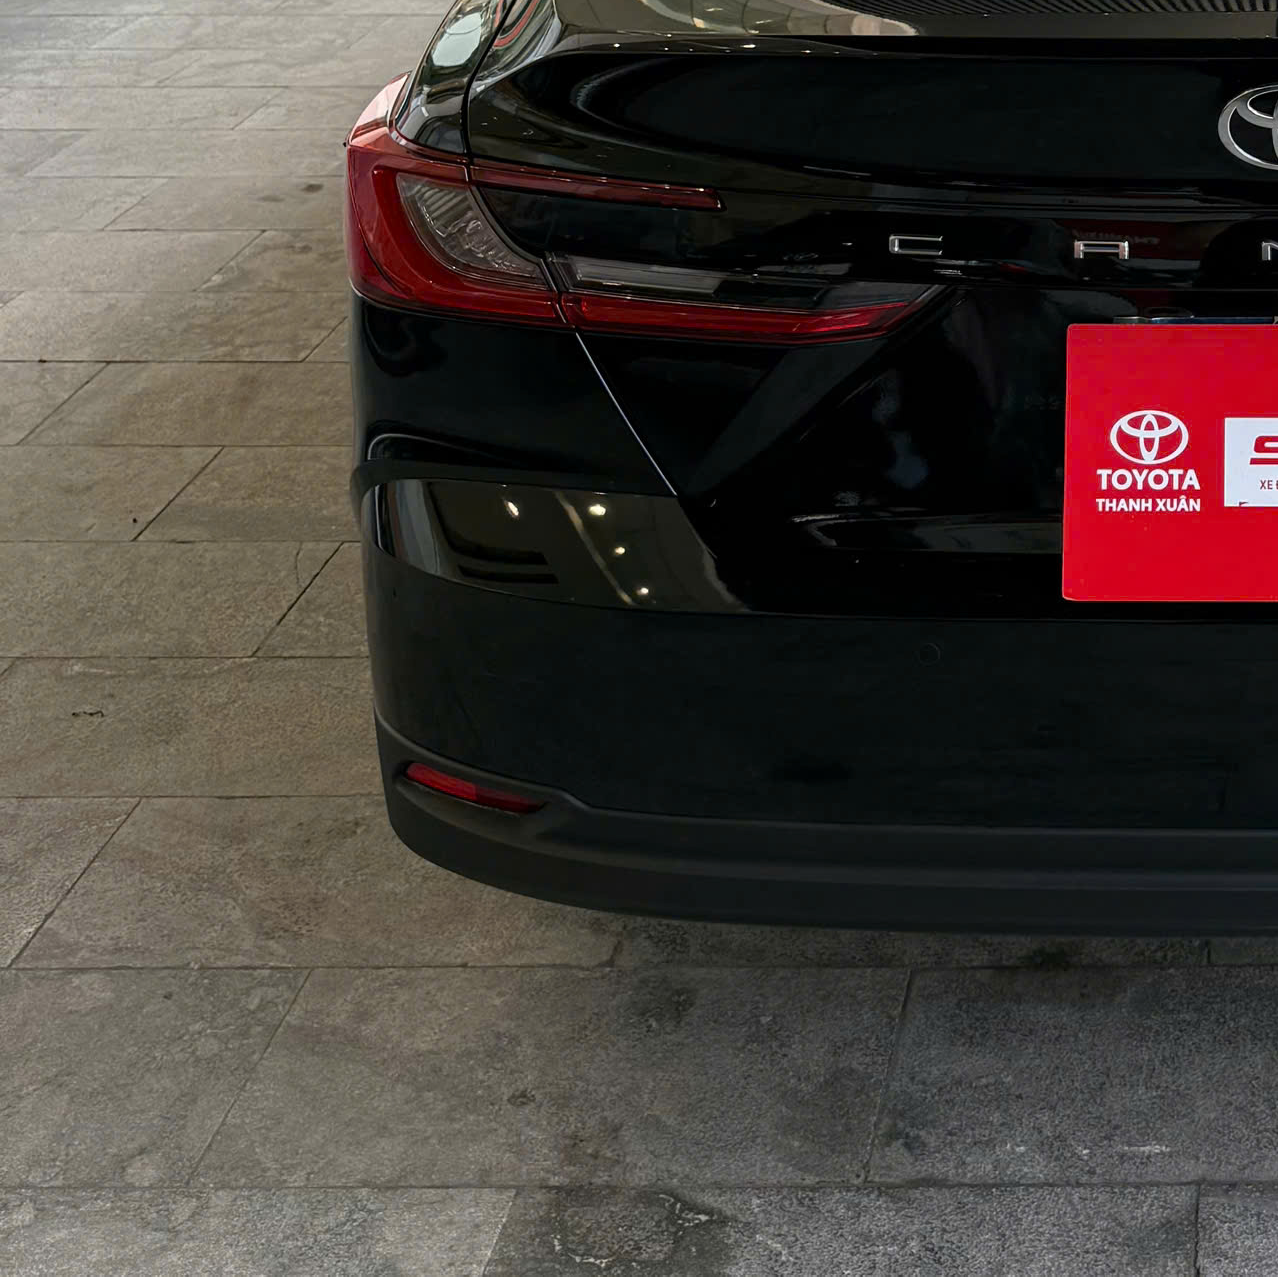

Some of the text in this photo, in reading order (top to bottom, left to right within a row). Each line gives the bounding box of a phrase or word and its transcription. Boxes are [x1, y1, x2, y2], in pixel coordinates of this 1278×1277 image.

[1096, 468, 1201, 491] TOYOTA
[1259, 479, 1273, 490] XE
[1095, 494, 1201, 512] THANH XUÂN
